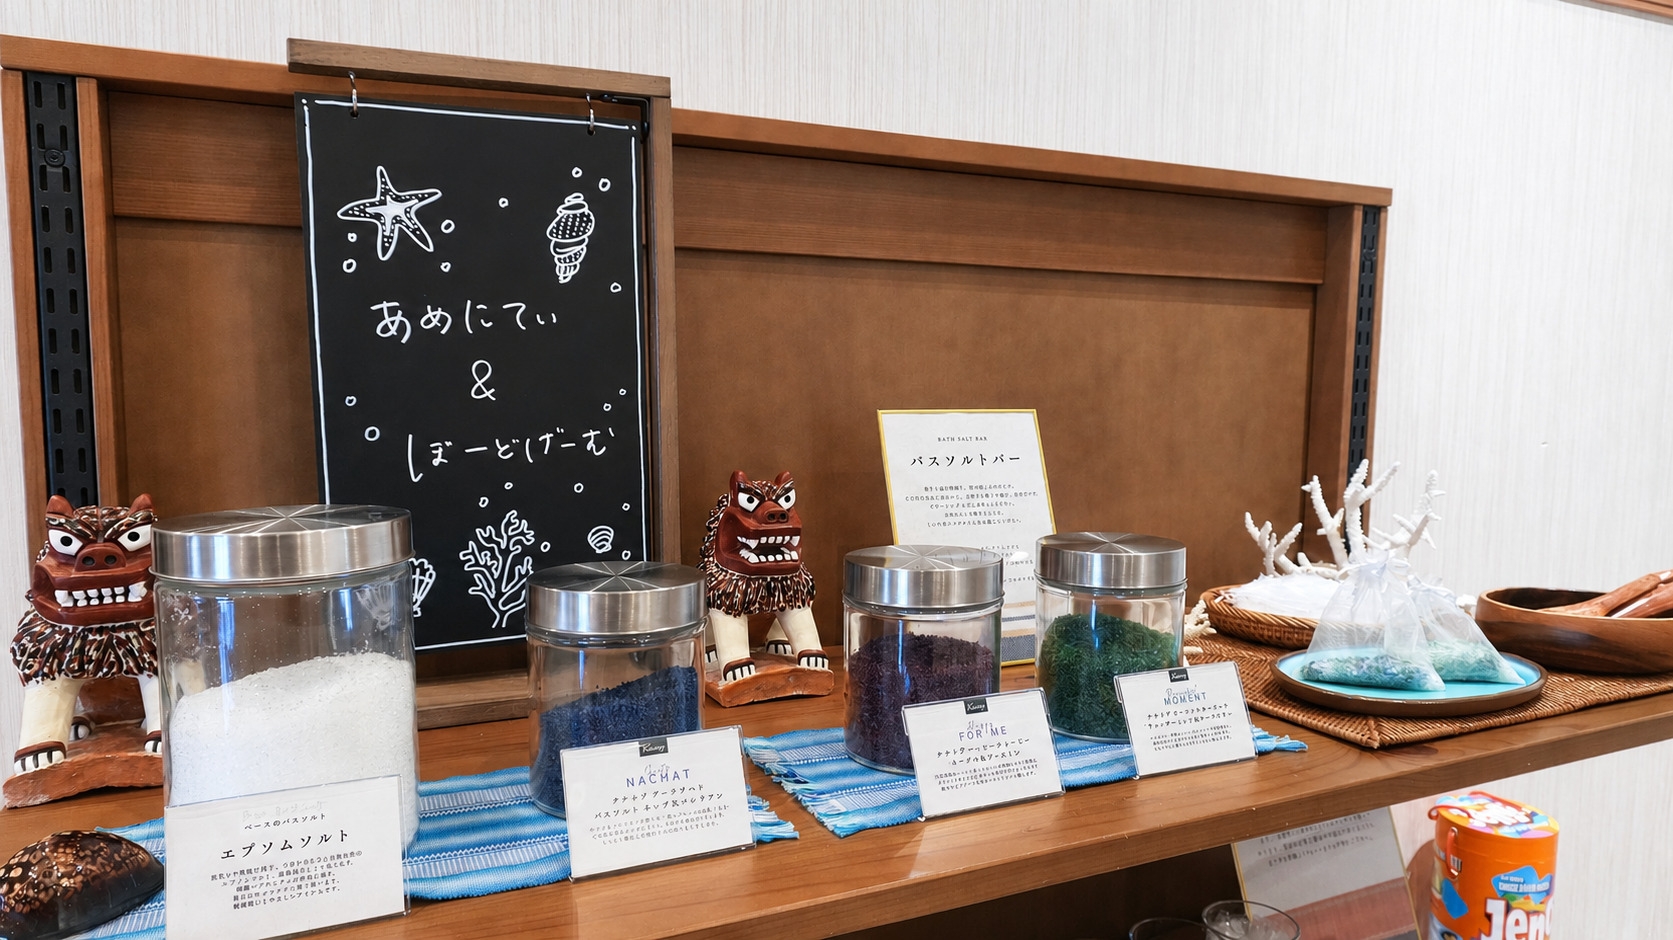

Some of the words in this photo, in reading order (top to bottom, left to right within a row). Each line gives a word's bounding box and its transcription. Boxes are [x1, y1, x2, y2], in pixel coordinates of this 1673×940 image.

[470, 359, 496, 401] &
[407, 426, 616, 483] ぼーどげーむ
[910, 453, 1021, 467] バスソルトバー
[1163, 692, 1207, 706] MOMENT
[958, 729, 983, 742] FOR
[990, 725, 1007, 737] ME
[220, 828, 350, 860] エプソムソルト
